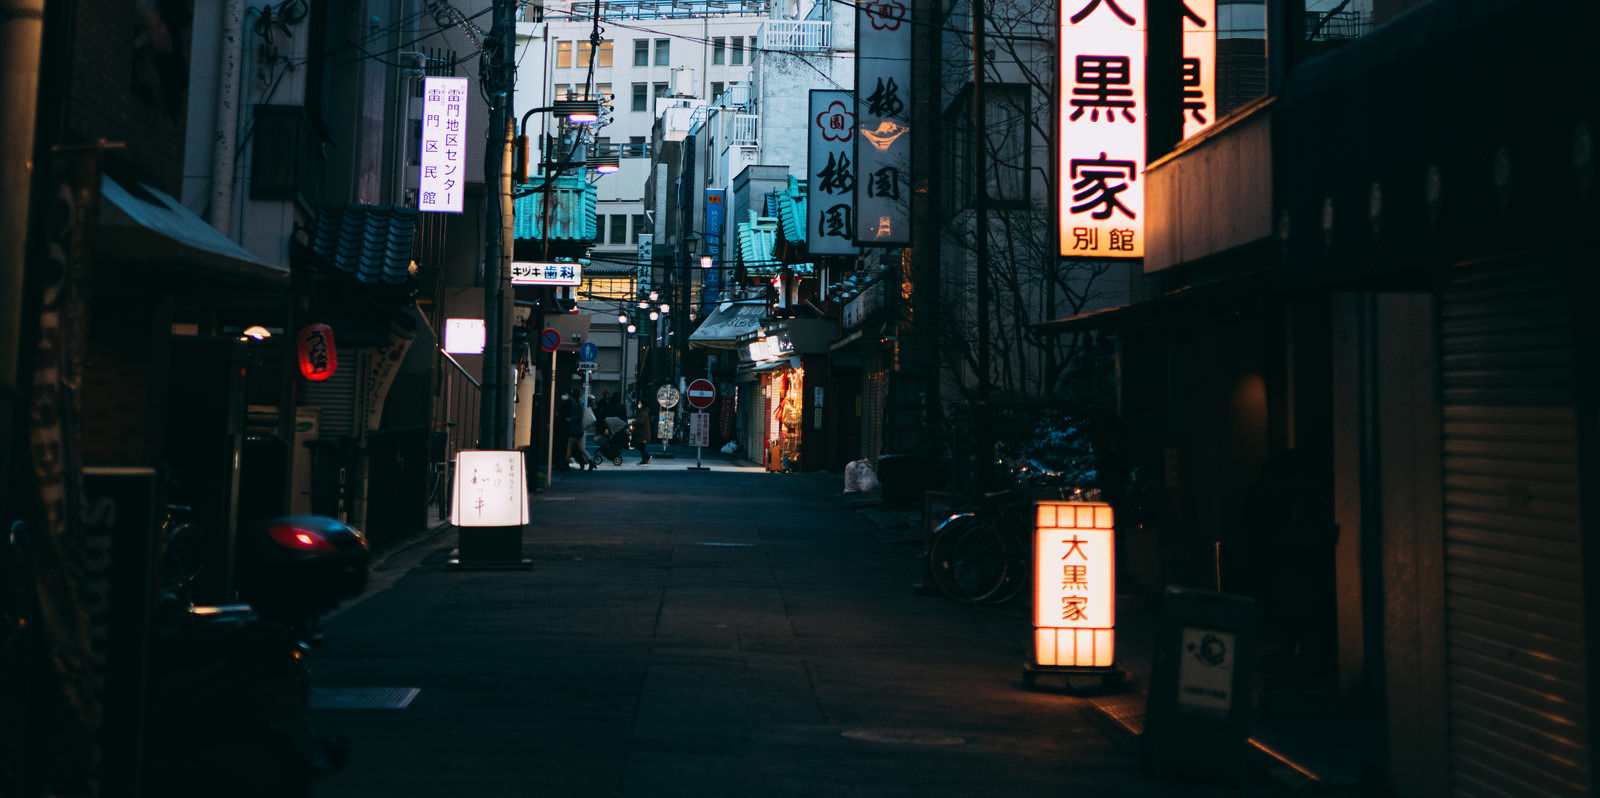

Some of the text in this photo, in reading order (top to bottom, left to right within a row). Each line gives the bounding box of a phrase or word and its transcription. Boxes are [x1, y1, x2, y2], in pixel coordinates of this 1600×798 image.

[422, 88, 441, 206] 雷門区民館
[444, 88, 462, 205] 雷門地区センター
[1072, 227, 1135, 252] 別館
[1061, 534, 1089, 622] 大黒家
